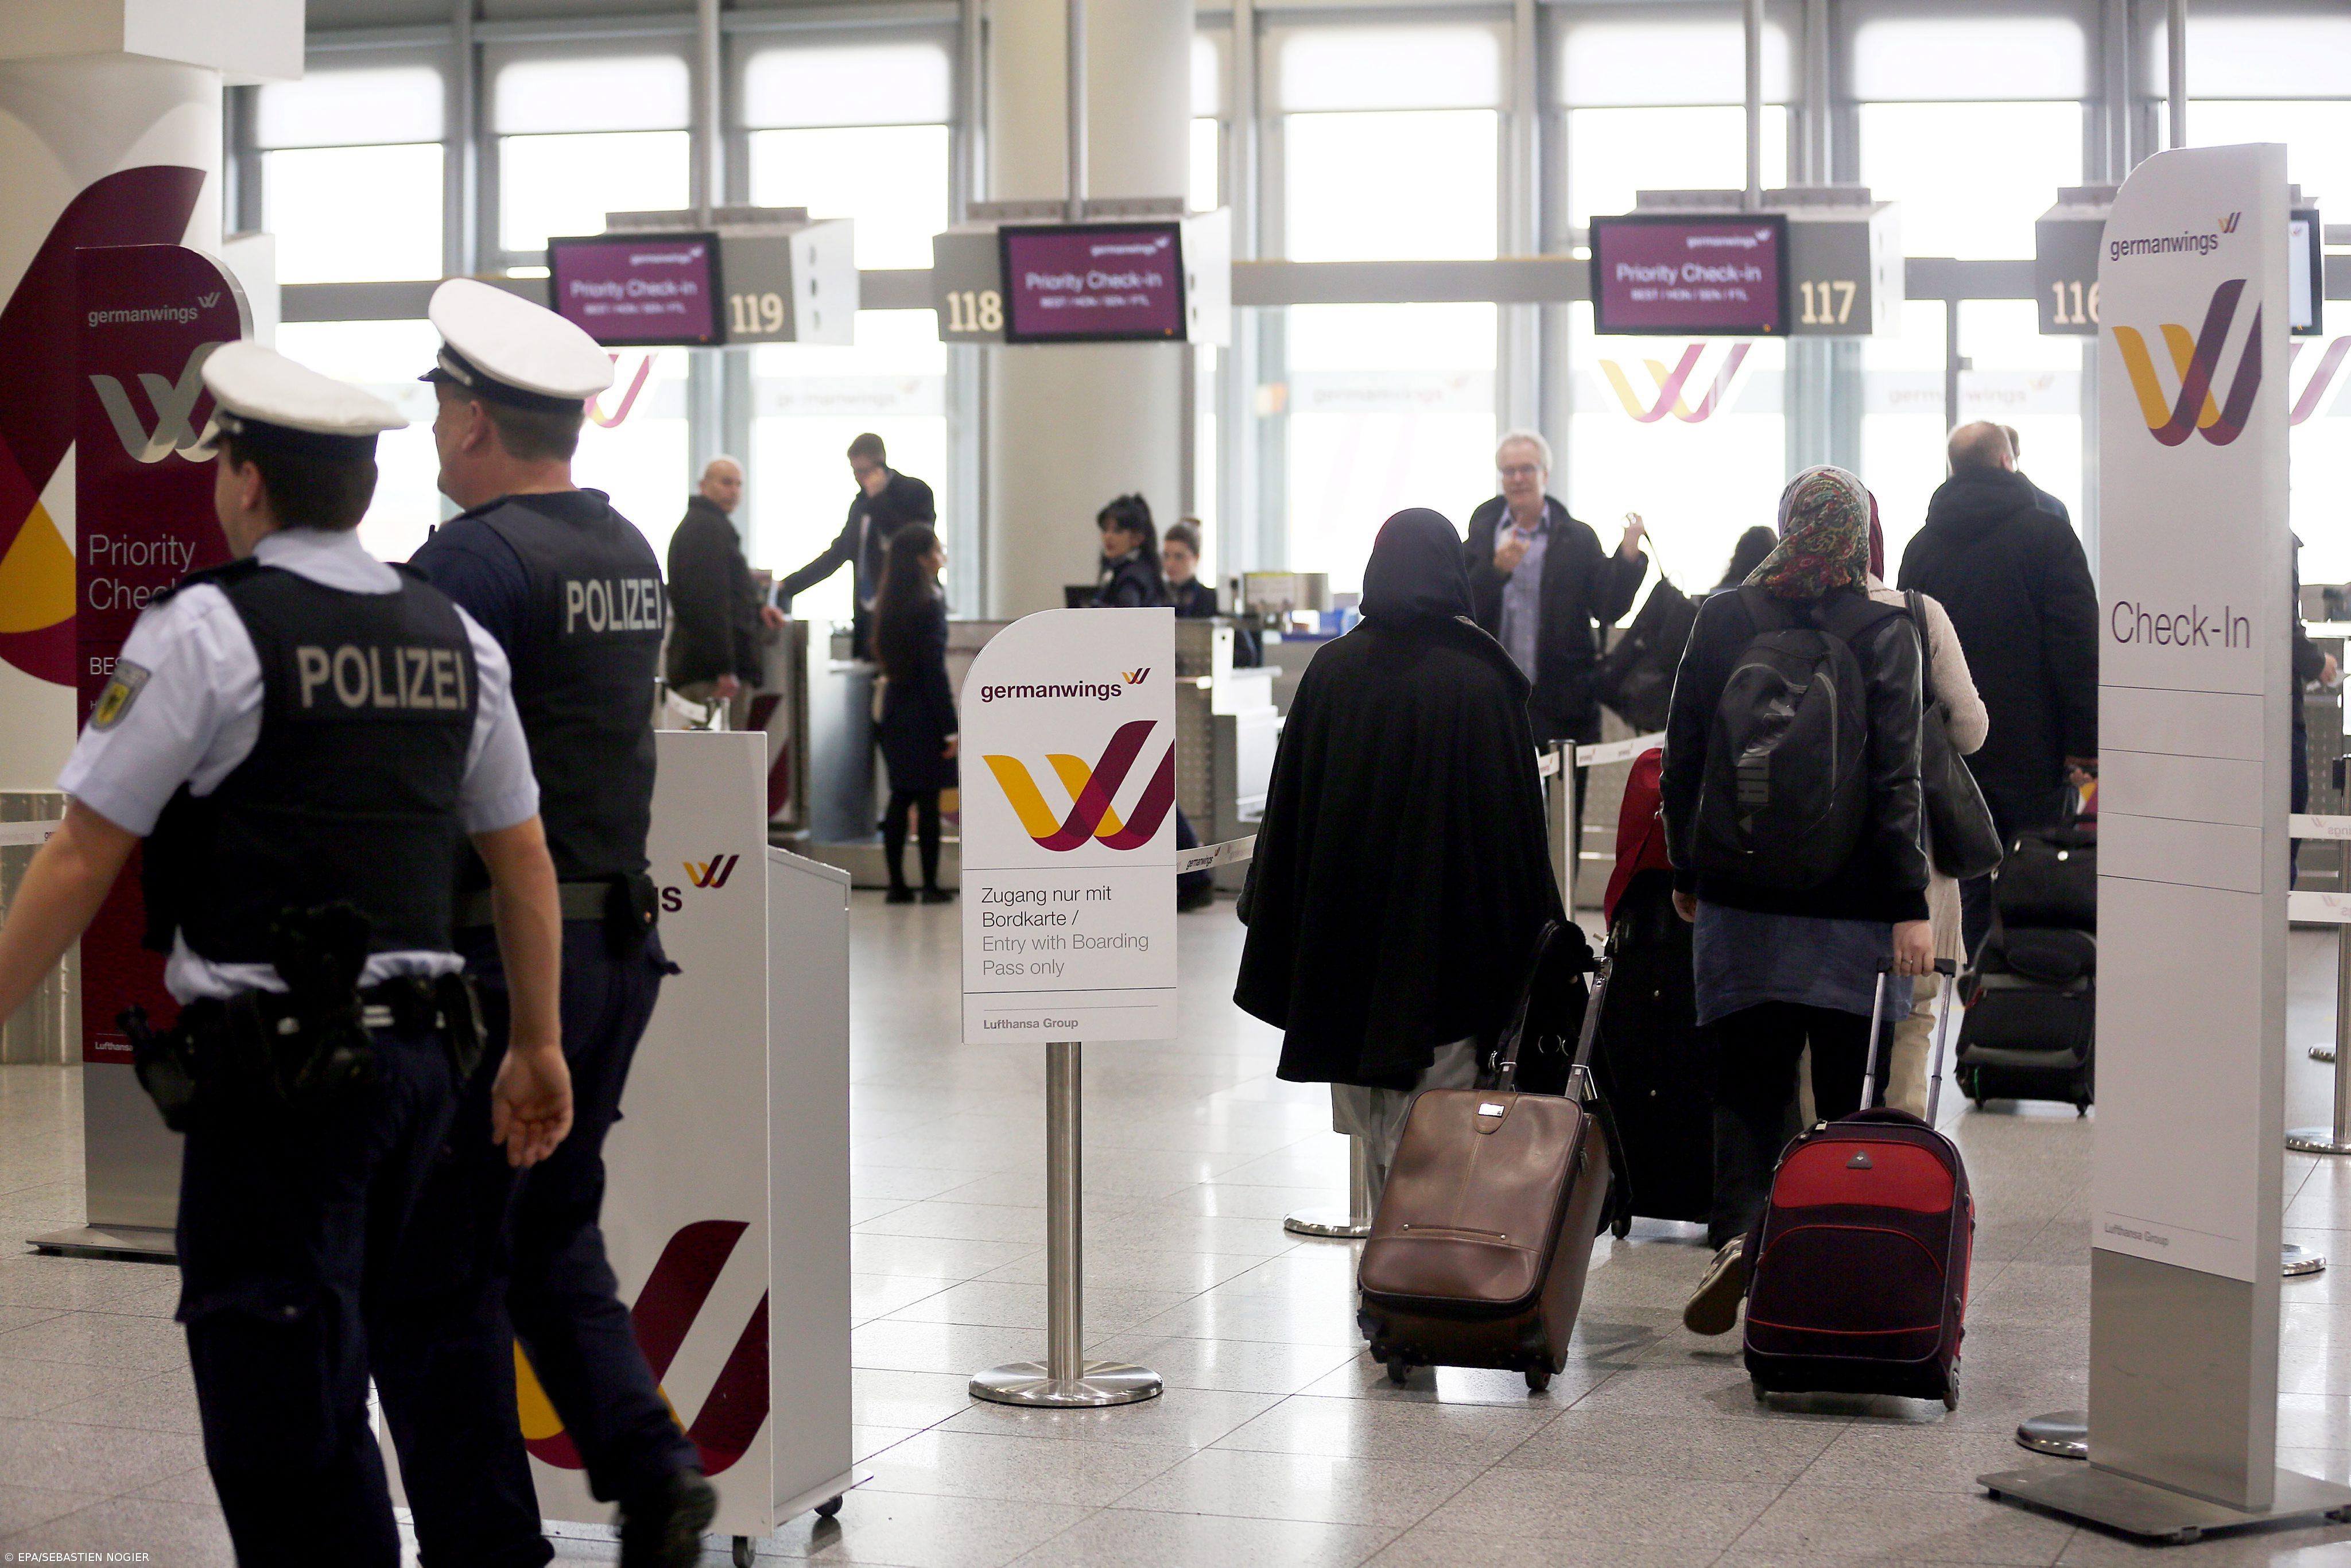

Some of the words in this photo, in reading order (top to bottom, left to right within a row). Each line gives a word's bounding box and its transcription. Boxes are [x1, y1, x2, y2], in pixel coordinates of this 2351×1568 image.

[2111, 230, 2218, 261] germanwings
[1025, 271, 1084, 293] Priority
[1616, 262, 1679, 285] Priority
[730, 293, 784, 333] 119
[948, 290, 1003, 332] 118
[1800, 280, 1856, 324] 117
[88, 305, 198, 328] germanwings
[89, 533, 196, 573] Priority
[566, 579, 663, 632] POLIZEI
[2112, 601, 2251, 648] Check-In
[296, 645, 468, 711] POLIZEI
[981, 681, 1122, 703] germanwings
[981, 887, 1046, 906] Zugang
[1053, 888, 1080, 901] nur
[1087, 886, 1111, 901] mit
[983, 911, 1066, 927] Bordkarte
[983, 936, 1026, 954] Entry
[1032, 934, 1066, 950] with
[1073, 933, 1149, 951] Boarding
[983, 960, 1024, 975] Pass
[1030, 958, 1065, 977] only
[983, 1019, 1039, 1029] Lufthansa
[1043, 1018, 1078, 1029] Group
